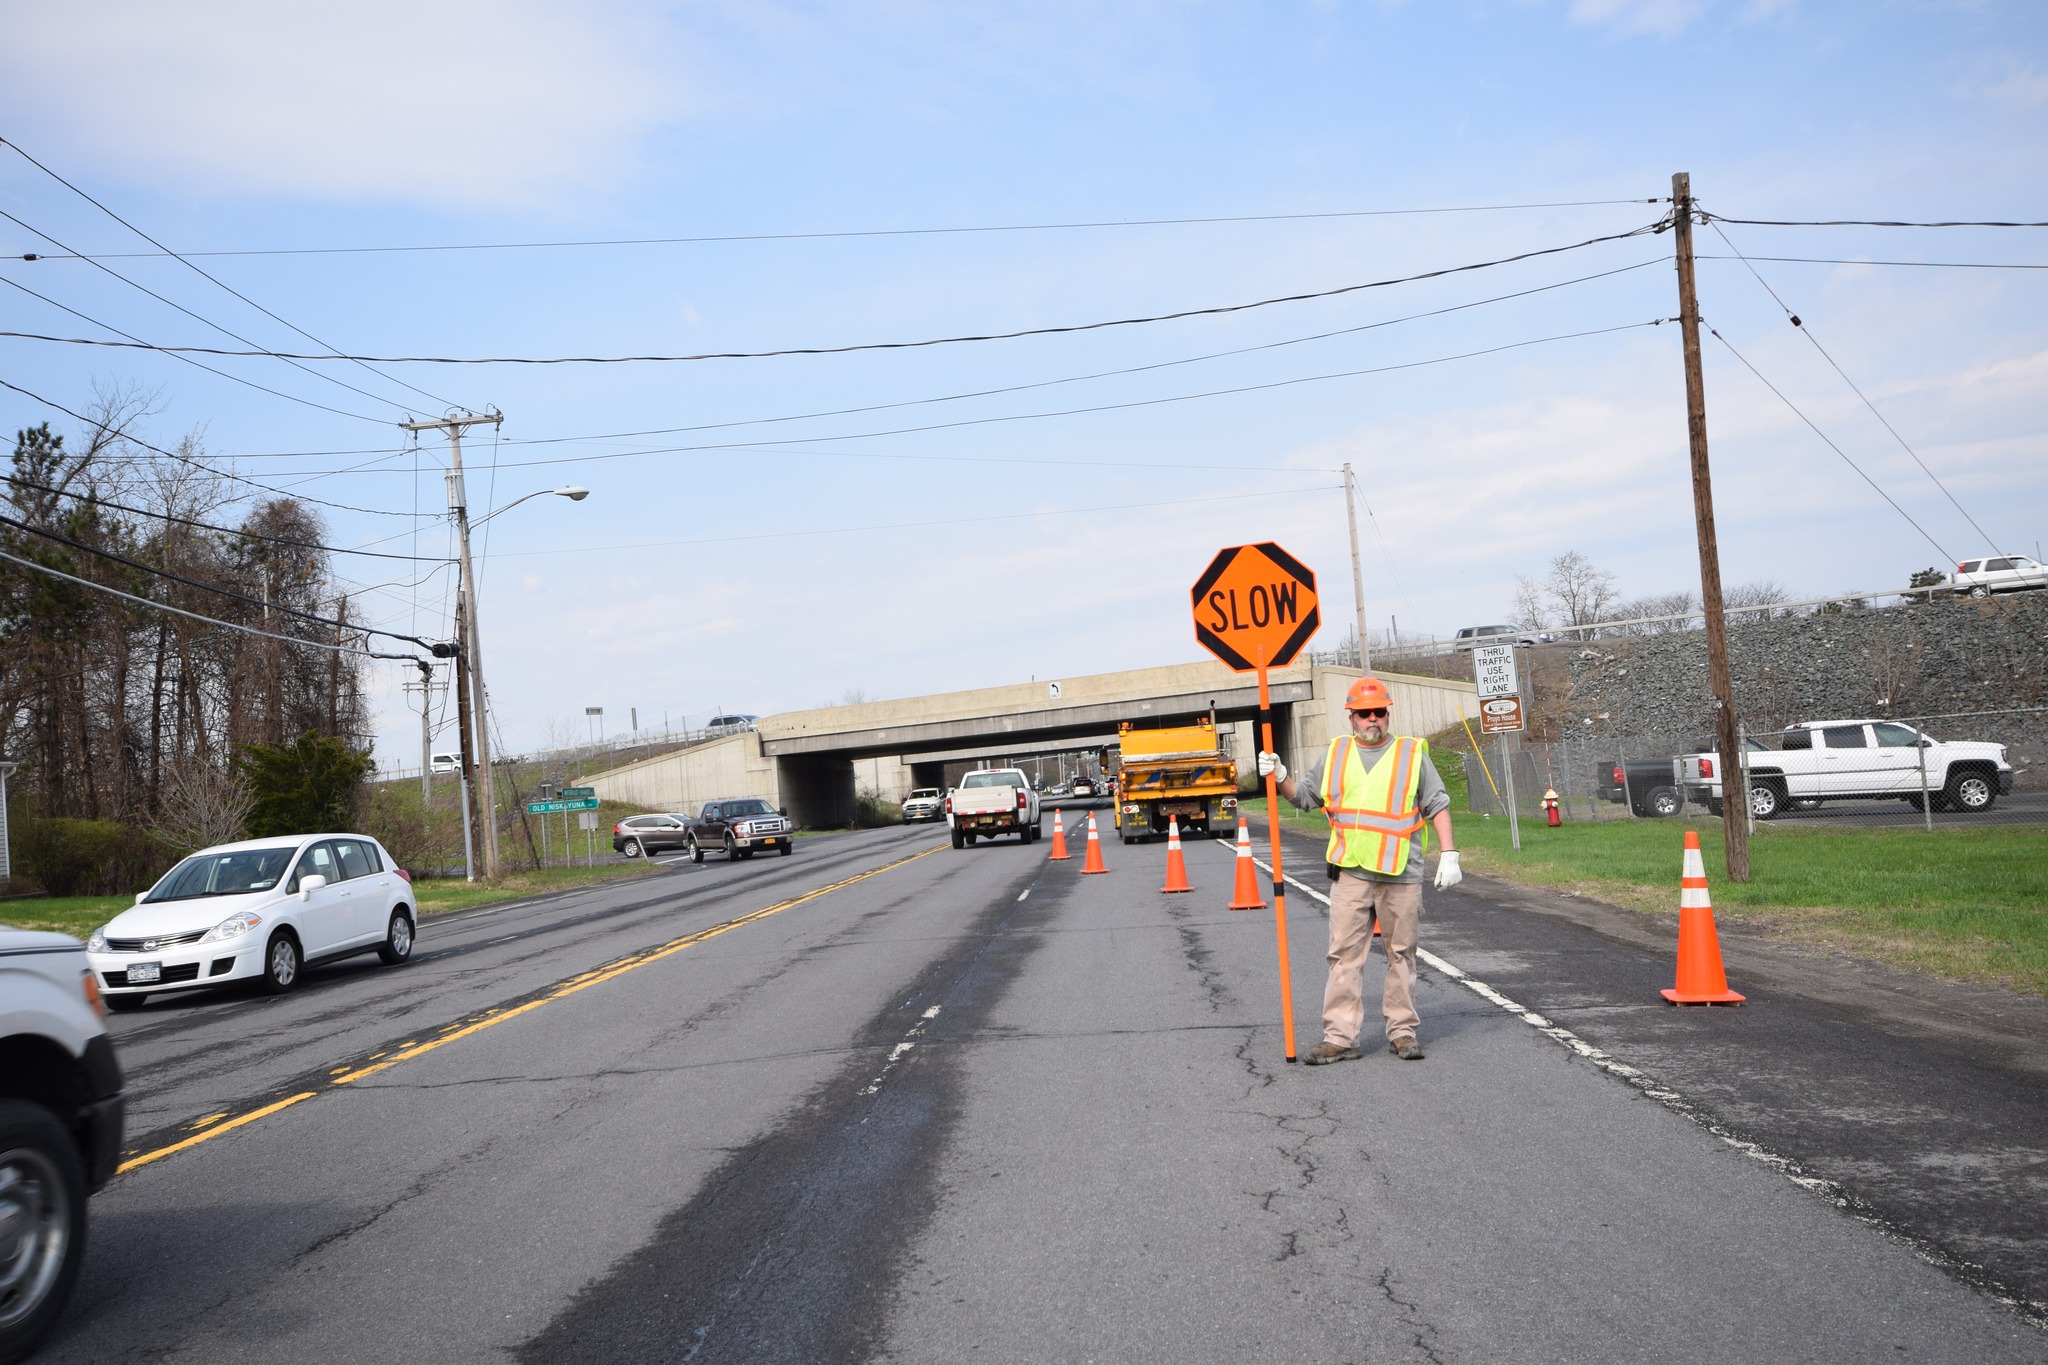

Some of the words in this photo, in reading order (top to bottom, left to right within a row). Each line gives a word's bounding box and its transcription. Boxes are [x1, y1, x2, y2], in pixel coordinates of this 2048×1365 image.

[1209, 581, 1297, 633] SLOW
[1482, 647, 1504, 657] THRU
[1477, 656, 1511, 666] TRAFFIC
[1487, 666, 1503, 675] USE
[1483, 674, 1509, 684] RIGHT
[1486, 684, 1509, 693] LANE
